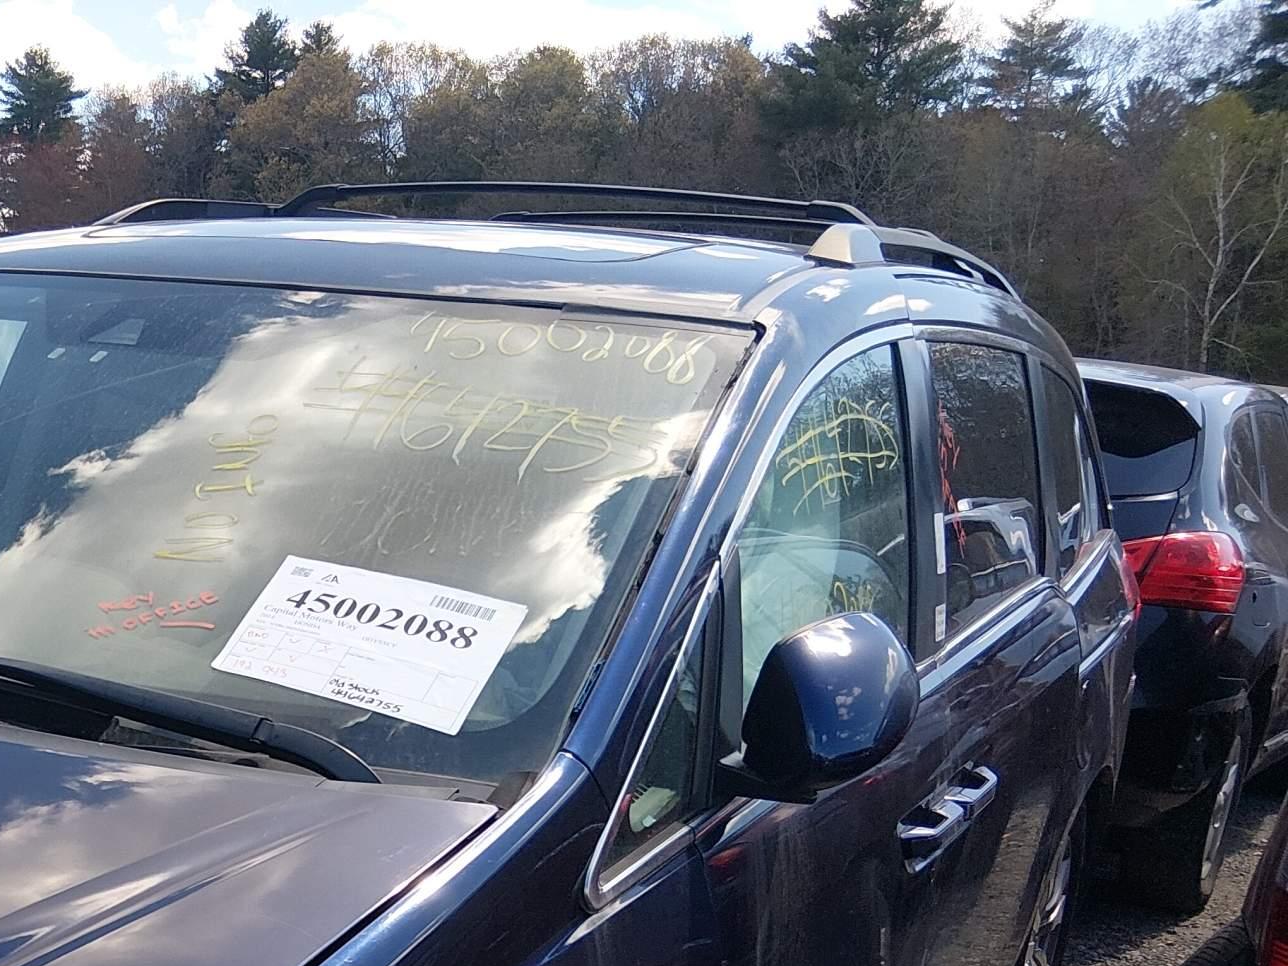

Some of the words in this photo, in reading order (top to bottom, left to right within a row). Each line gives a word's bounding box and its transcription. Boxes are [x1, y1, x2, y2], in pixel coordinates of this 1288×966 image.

[410, 311, 713, 385] 45002088
[263, 604, 297, 617] Capital
[286, 589, 479, 649] 45002088
[331, 688, 404, 713] 44642755
